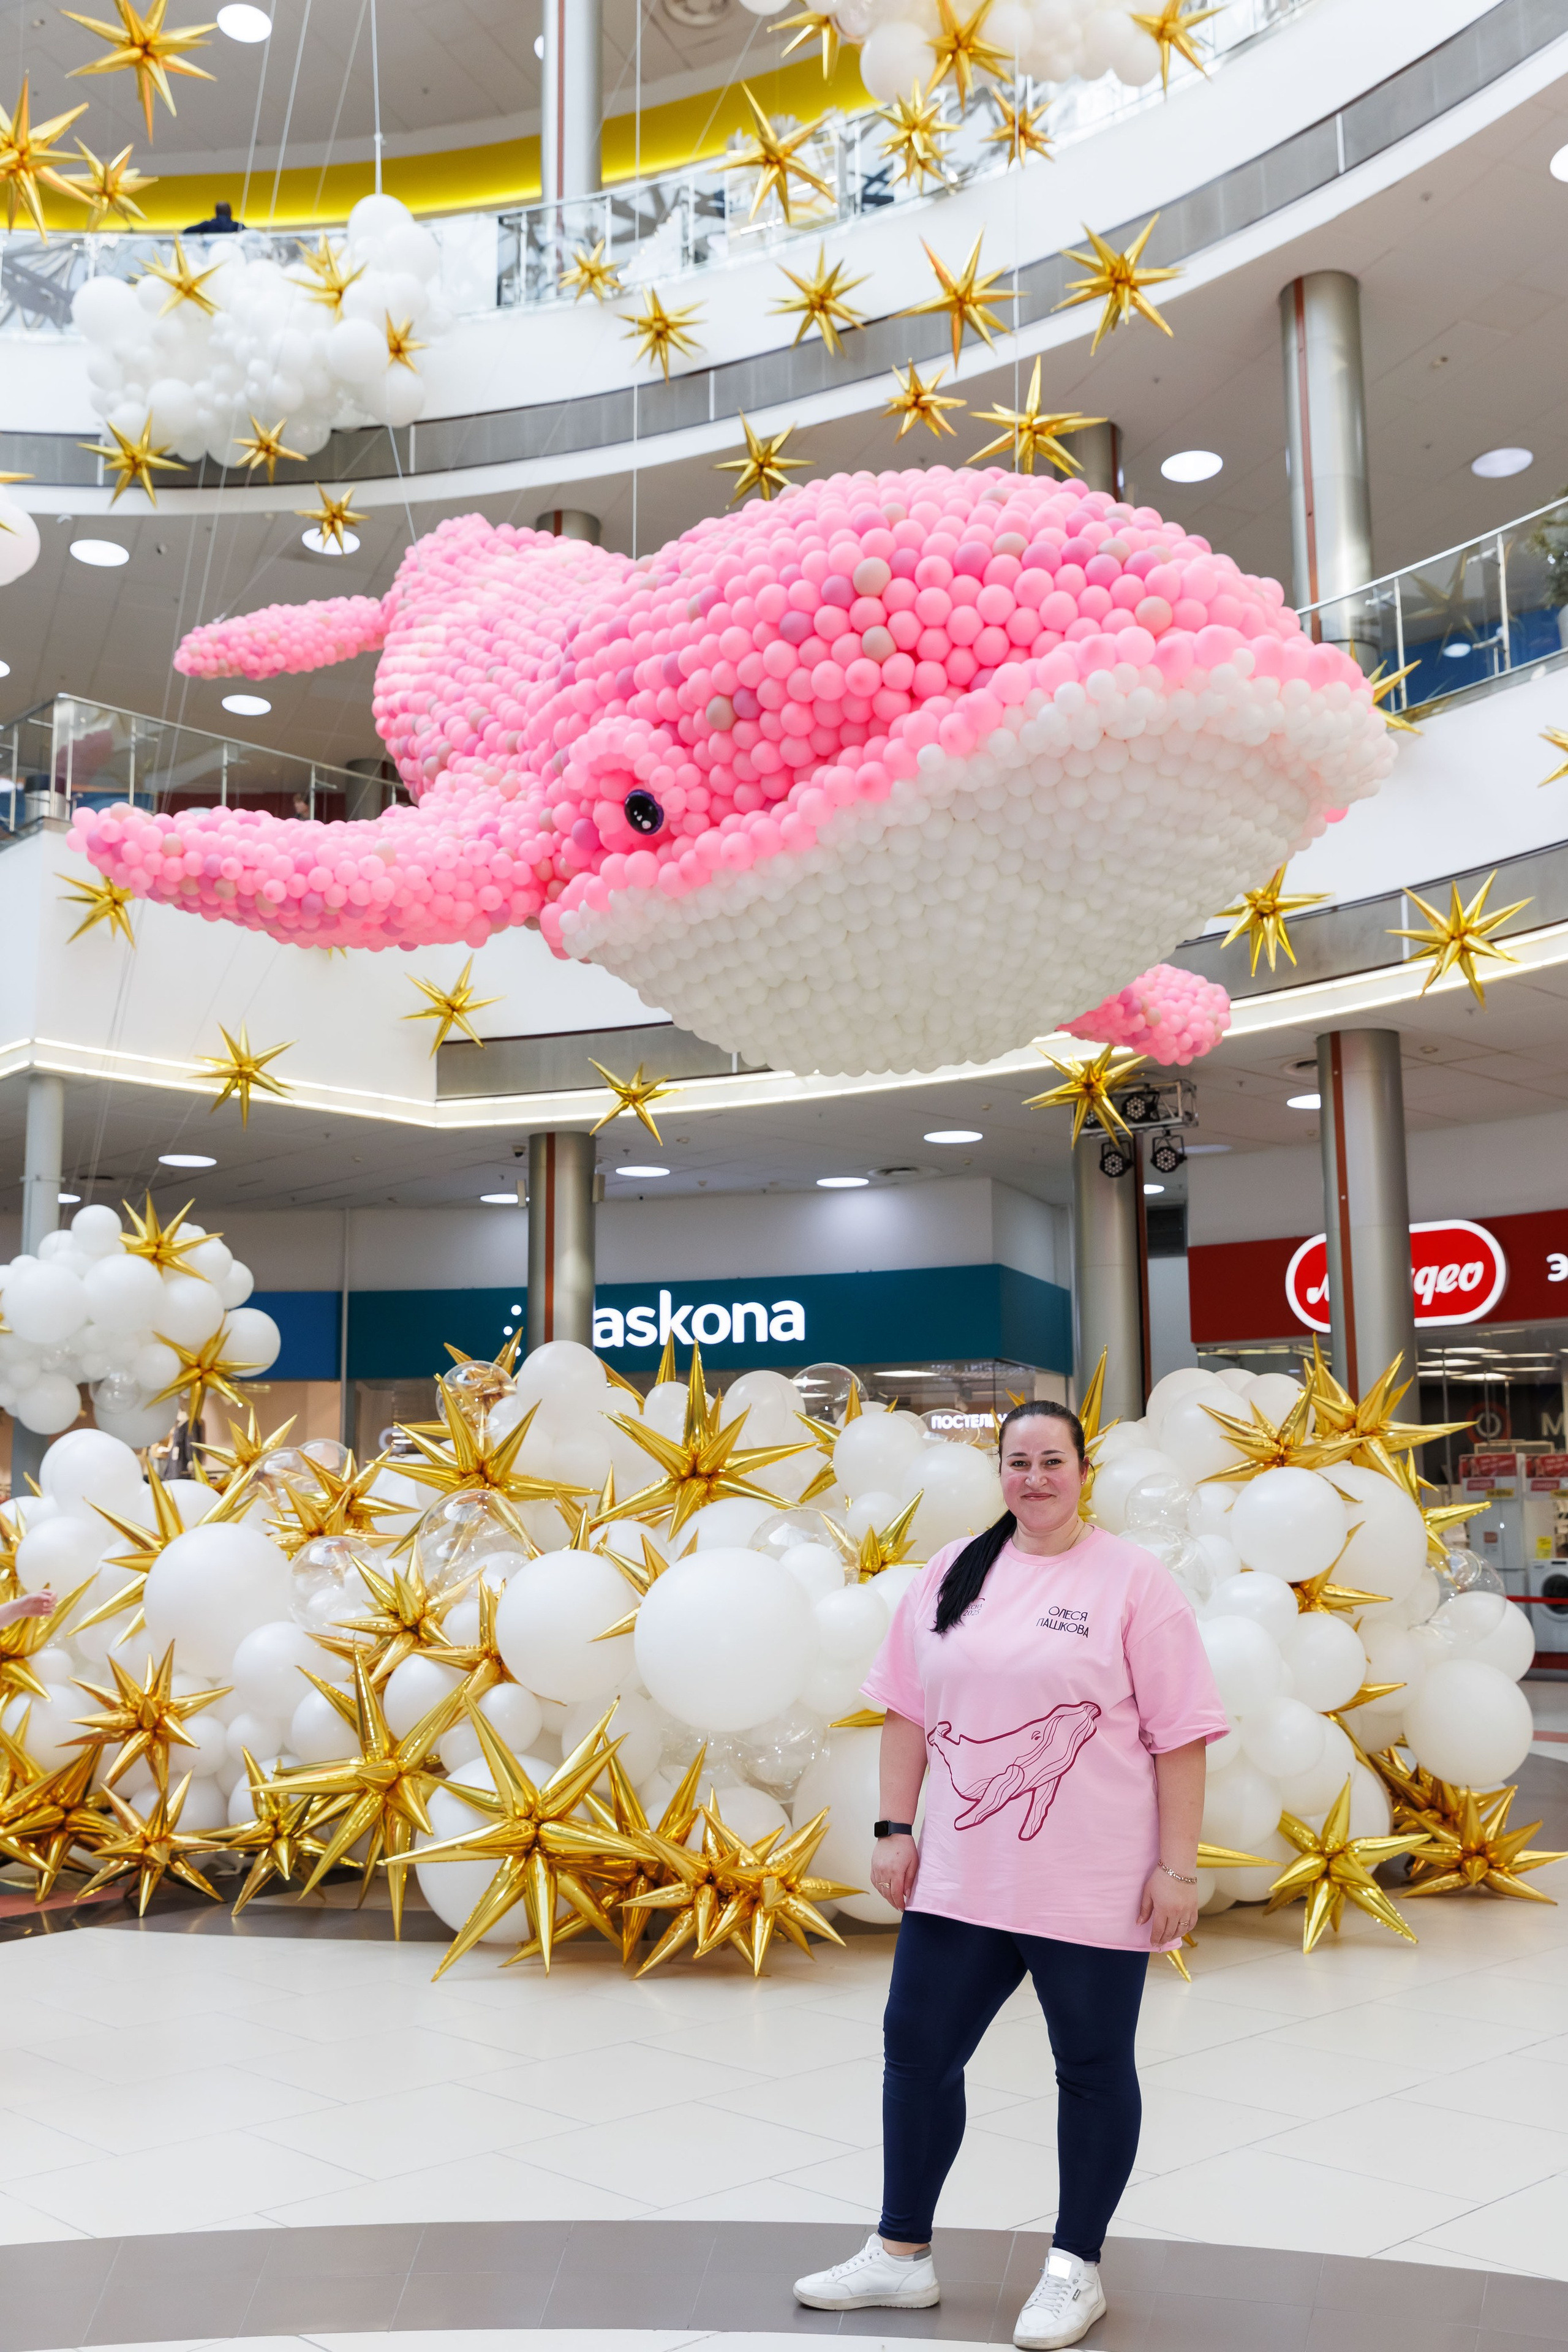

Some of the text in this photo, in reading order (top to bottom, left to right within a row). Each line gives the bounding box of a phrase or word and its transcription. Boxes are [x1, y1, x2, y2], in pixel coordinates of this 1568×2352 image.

[593, 1289, 805, 1348] askona
[1048, 1606, 1088, 1621] ОЛЕСЯ
[1036, 1618, 1089, 1638] ПАШКОВА
